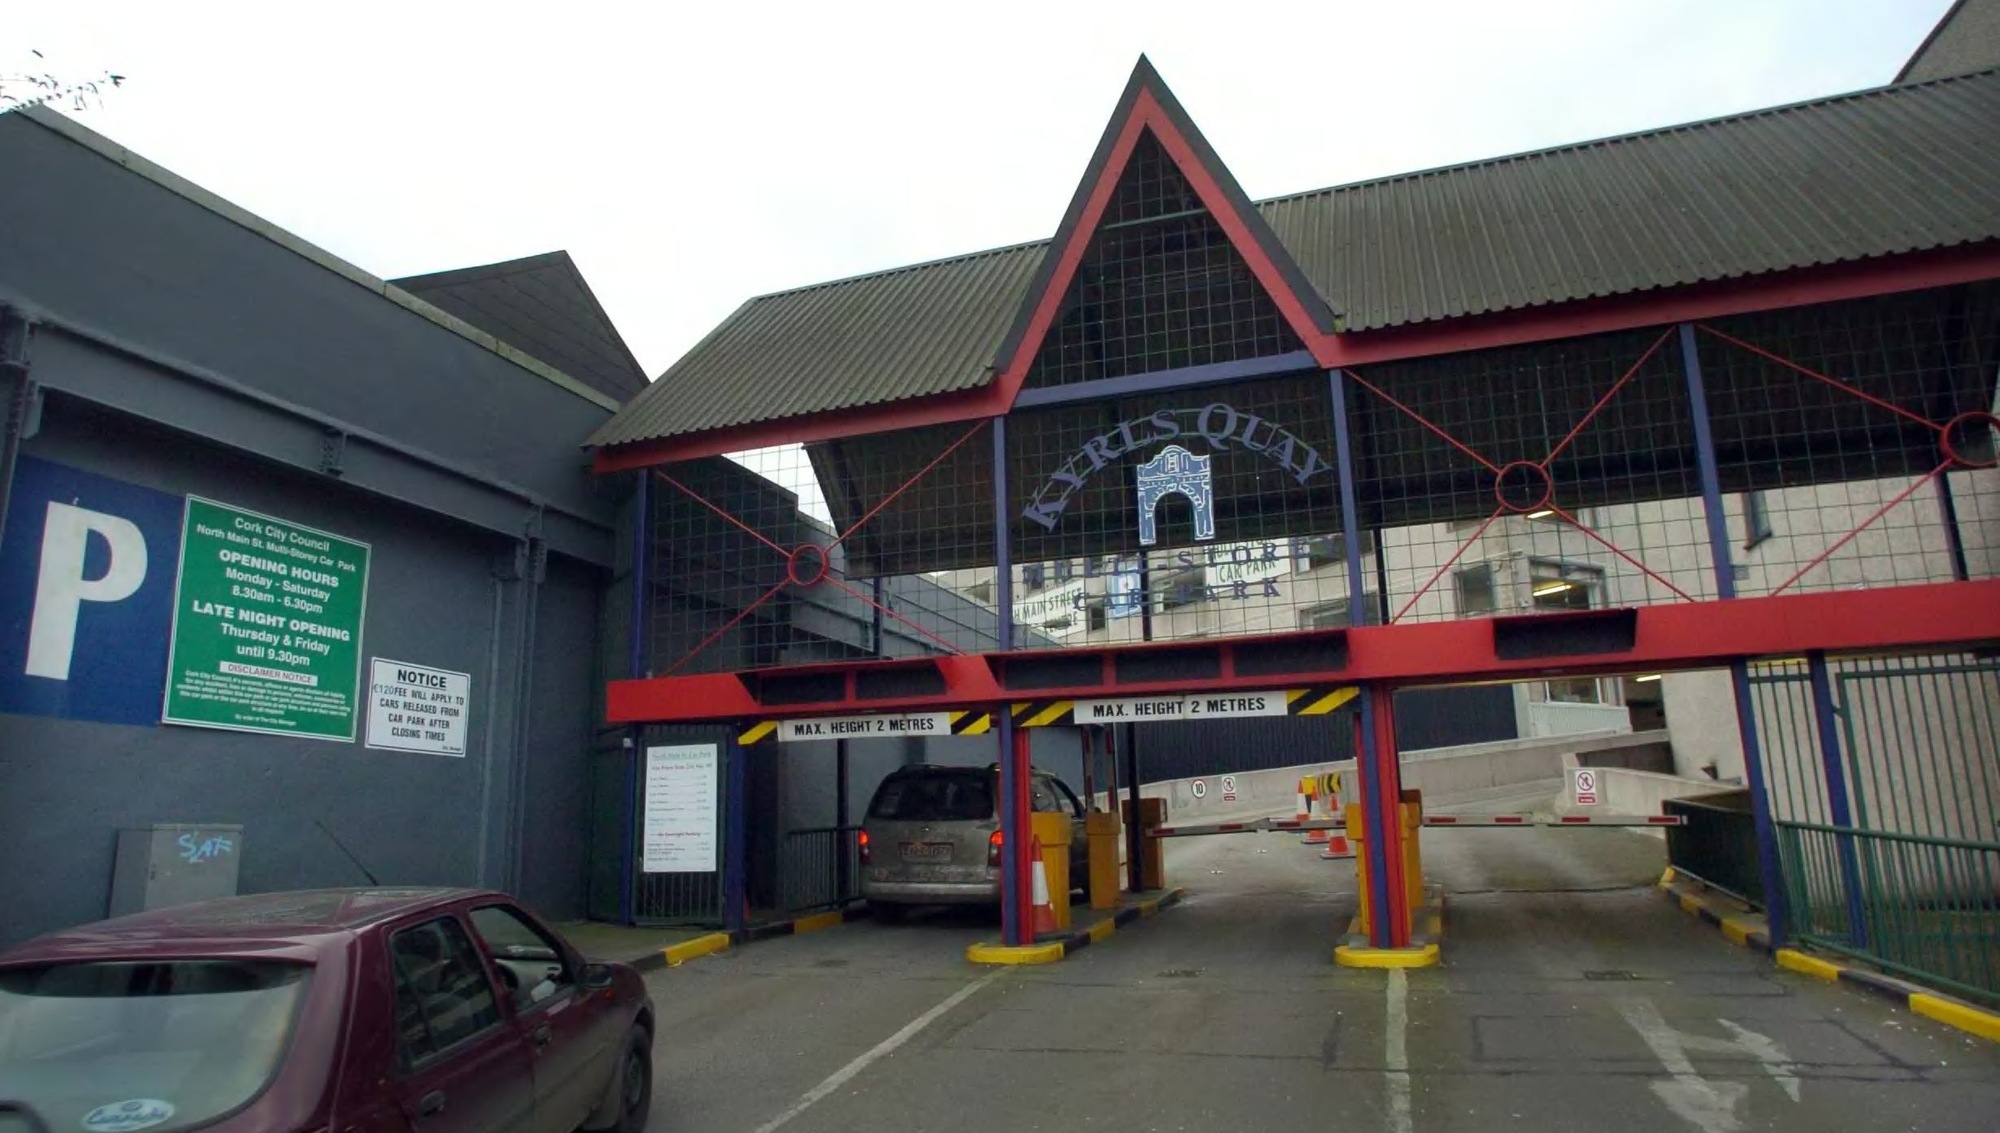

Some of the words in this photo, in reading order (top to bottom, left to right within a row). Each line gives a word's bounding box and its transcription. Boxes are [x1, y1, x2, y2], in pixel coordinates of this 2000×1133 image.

[1197, 403, 1333, 485] QUAY
[235, 518, 262, 534] Cork
[265, 526, 286, 541] City
[290, 532, 330, 551] Council
[197, 523, 225, 538] North
[227, 530, 250, 545] Main
[251, 536, 264, 549] St.
[266, 540, 318, 564] Multi-Storey
[320, 555, 335, 567] Car
[338, 560, 356, 572] Park
[219, 549, 287, 575] OPENING
[291, 566, 339, 587] HOURS
[1220, 564, 1242, 583] CAR
[25, 500, 148, 680] P
[226, 567, 273, 589] Monday
[282, 580, 330, 602] Saturday
[232, 585, 275, 603] 8.30am
[284, 596, 323, 614] 6.30pm
[1022, 598, 1046, 620] MAIN
[193, 600, 235, 618] LATE
[238, 608, 287, 628] NIGHT
[289, 618, 350, 641] OPENING
[221, 622, 280, 646] Thursday
[283, 636, 291, 646] &
[295, 638, 330, 656] Friday
[236, 643, 265, 658] until
[267, 648, 310, 667] 9.30pm
[227, 663, 280, 678] DISCLAIMER
[282, 671, 314, 684] NOTICE
[397, 669, 447, 688] NOTICE
[380, 698, 399, 709] CARS
[403, 701, 437, 714] RELEASED
[441, 707, 460, 717] FROM
[411, 690, 426, 700] WILL
[431, 693, 453, 704] APPLY
[456, 697, 465, 706] TO
[1093, 704, 1128, 717] MAX.
[1135, 701, 1184, 716] HEIGHT
[1191, 700, 1200, 713] 2
[1207, 697, 1265, 713] METRES
[388, 713, 403, 723] CAR
[407, 716, 425, 726] PARK
[429, 719, 450, 729] AFTER
[794, 723, 826, 736] MAX.
[831, 720, 872, 734] HEIGHT
[877, 720, 884, 732] 2
[890, 718, 934, 731] METRES
[392, 727, 420, 739] CLOSING
[425, 731, 445, 741] TIMES
[1194, 783, 1204, 795] 10
